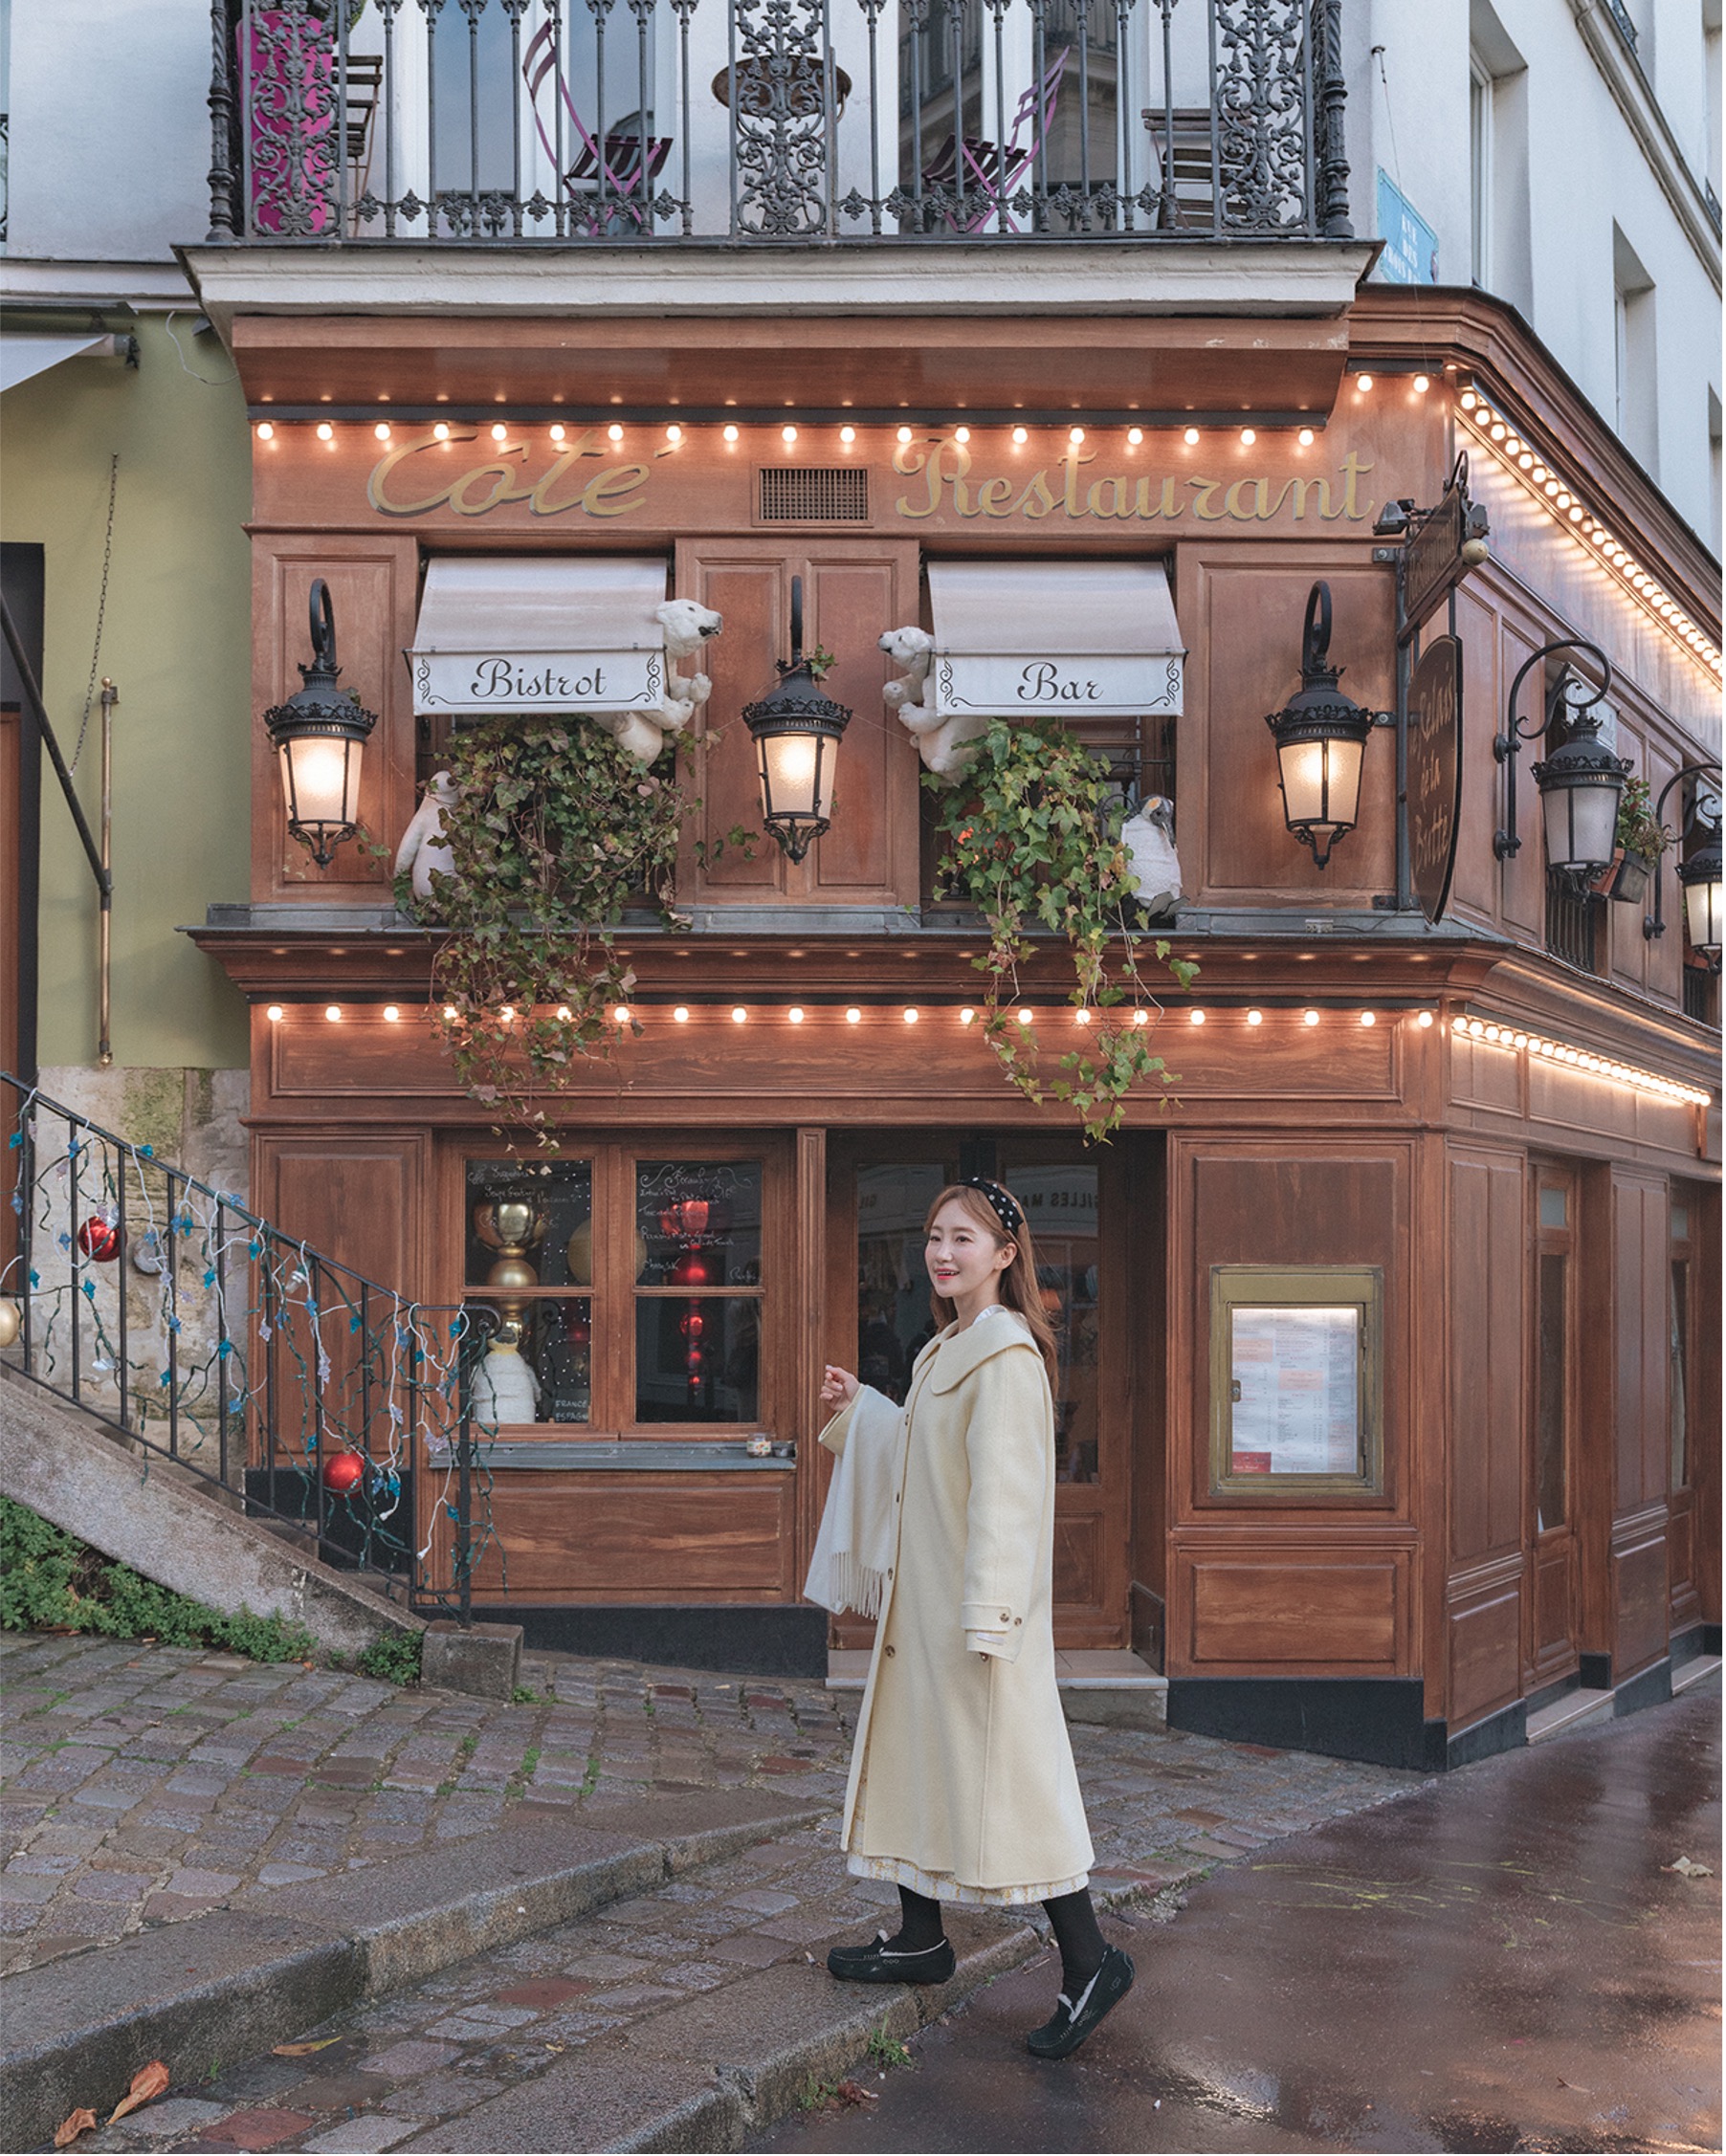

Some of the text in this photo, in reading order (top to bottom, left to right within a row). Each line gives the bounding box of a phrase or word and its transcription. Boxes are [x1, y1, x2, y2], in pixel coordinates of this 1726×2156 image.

[367, 429, 687, 517] Côté
[892, 437, 1376, 521] Restaurant
[470, 656, 609, 697] Bistrot
[1016, 661, 1104, 701] Bar
[554, 1398, 587, 1409] FRANCE
